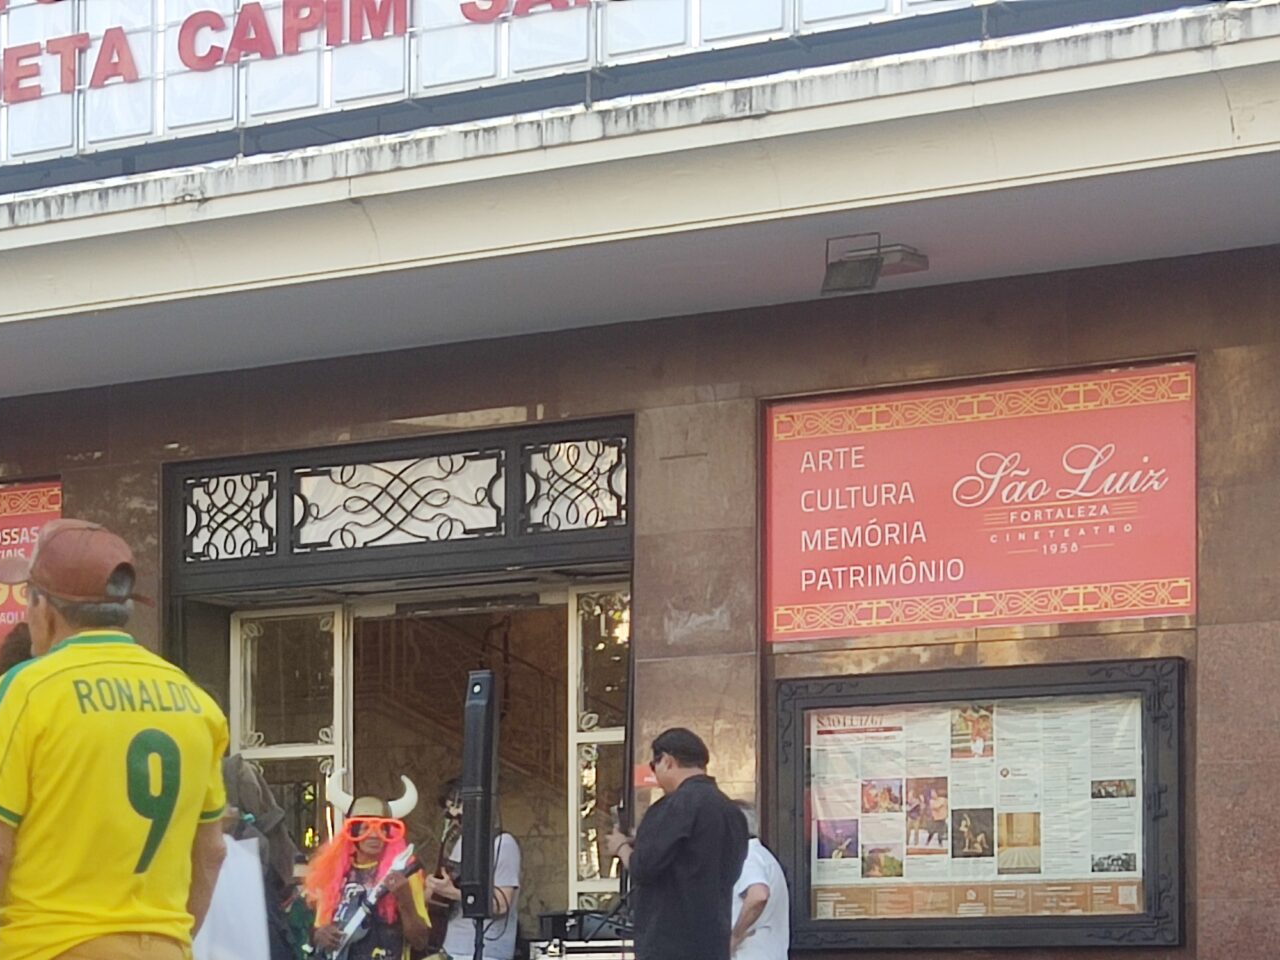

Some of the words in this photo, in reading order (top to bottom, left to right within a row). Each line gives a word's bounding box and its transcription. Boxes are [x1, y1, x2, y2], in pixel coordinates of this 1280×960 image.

[178, 0, 408, 71] CAPIM
[800, 446, 865, 473] ARTE
[952, 451, 1051, 508] São
[1056, 443, 1169, 500] Luiz
[801, 482, 915, 512] CULTURA
[1010, 504, 1110, 523] FORTALEZA
[801, 518, 927, 553] MEMÓRIA
[990, 523, 1133, 543] CINETEATRO
[1043, 542, 1079, 555] 1958
[801, 556, 965, 592] PATRIMÔNIO
[72, 677, 203, 715] RONALDO
[125, 727, 182, 875] 9
